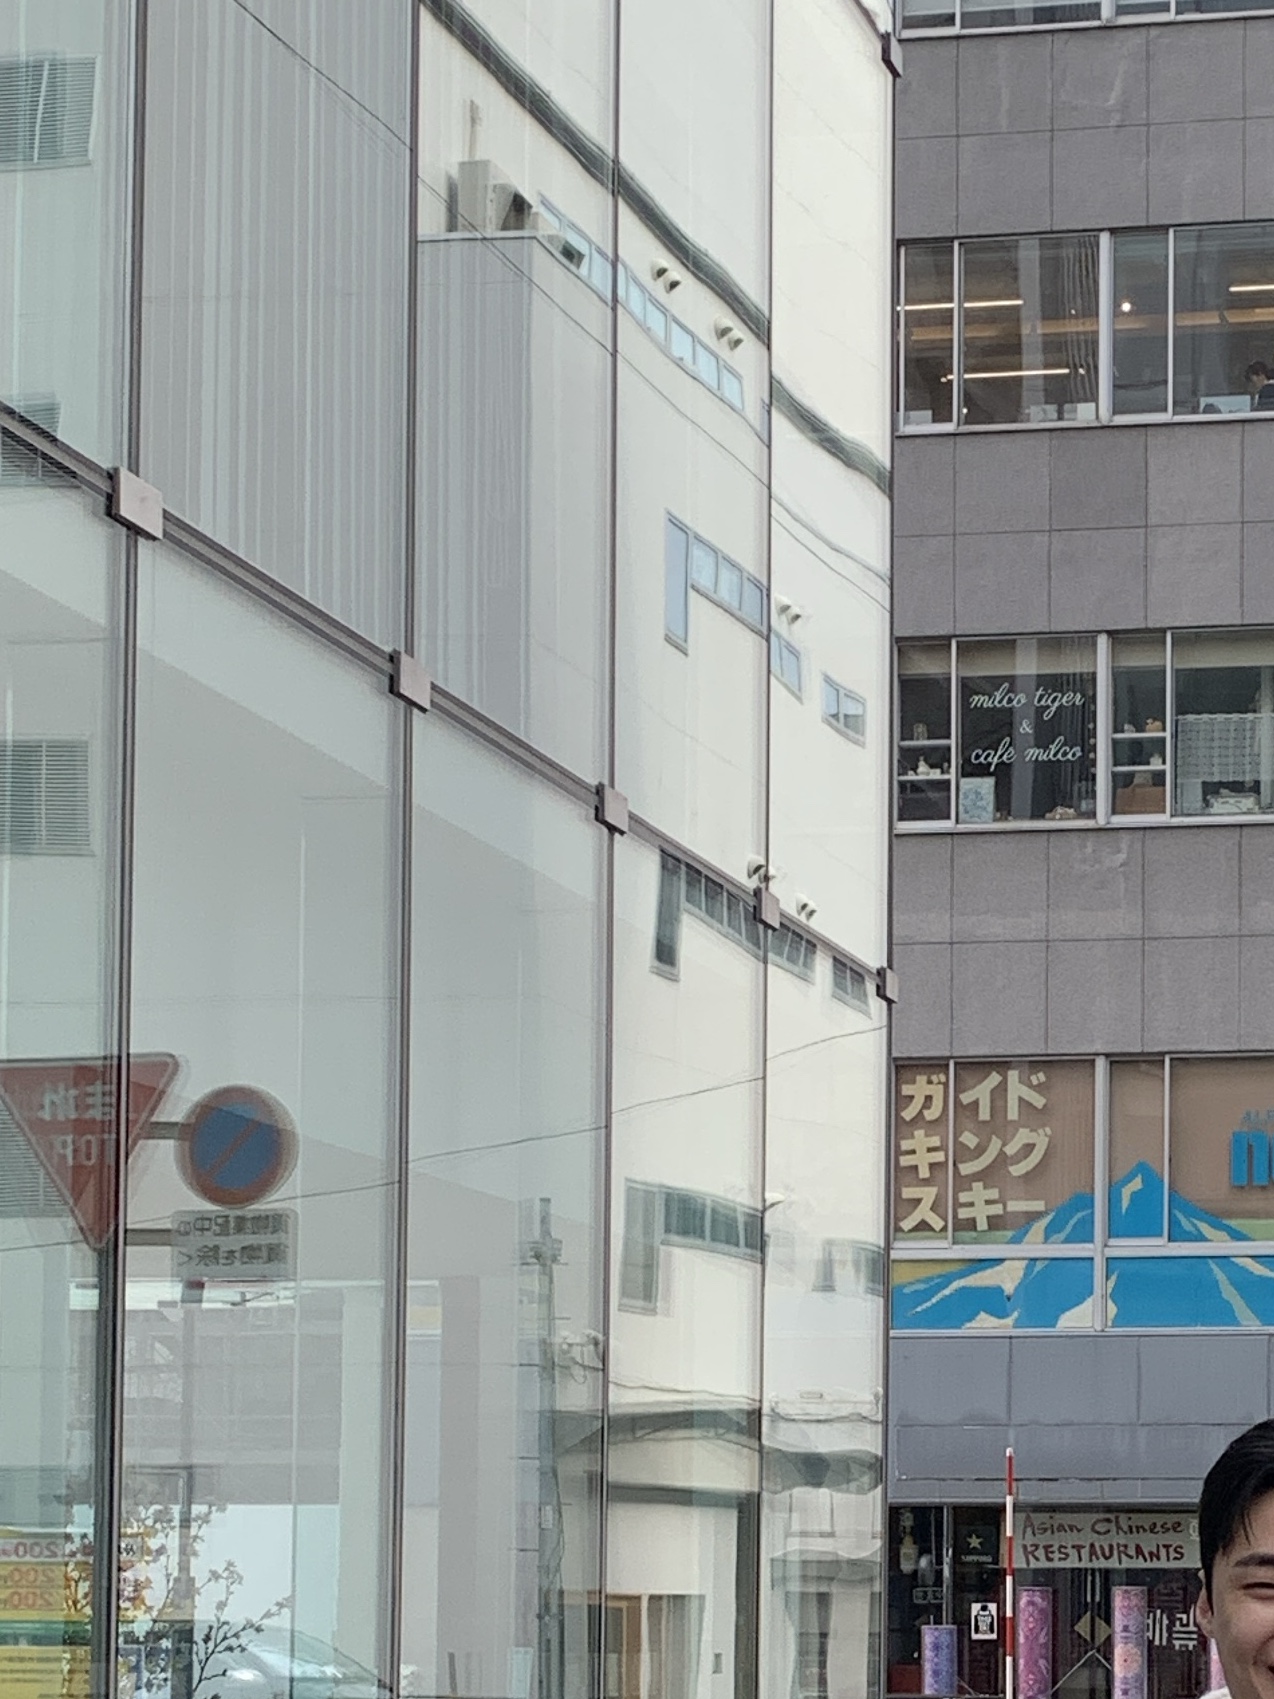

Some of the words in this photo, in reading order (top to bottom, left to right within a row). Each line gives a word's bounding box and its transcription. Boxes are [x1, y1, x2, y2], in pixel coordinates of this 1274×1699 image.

[969, 682, 1027, 709] milco
[1033, 686, 1085, 720] tiger
[1019, 719, 1034, 734] &
[1024, 735, 1083, 762] milco
[900, 1069, 1048, 1122] ガイド
[899, 1126, 1053, 1179] キング
[899, 1181, 1046, 1232] スキー
[1022, 1513, 1084, 1541] Asian
[1090, 1515, 1184, 1538] Chinese
[1021, 1542, 1186, 1568] RESTAURANTS
